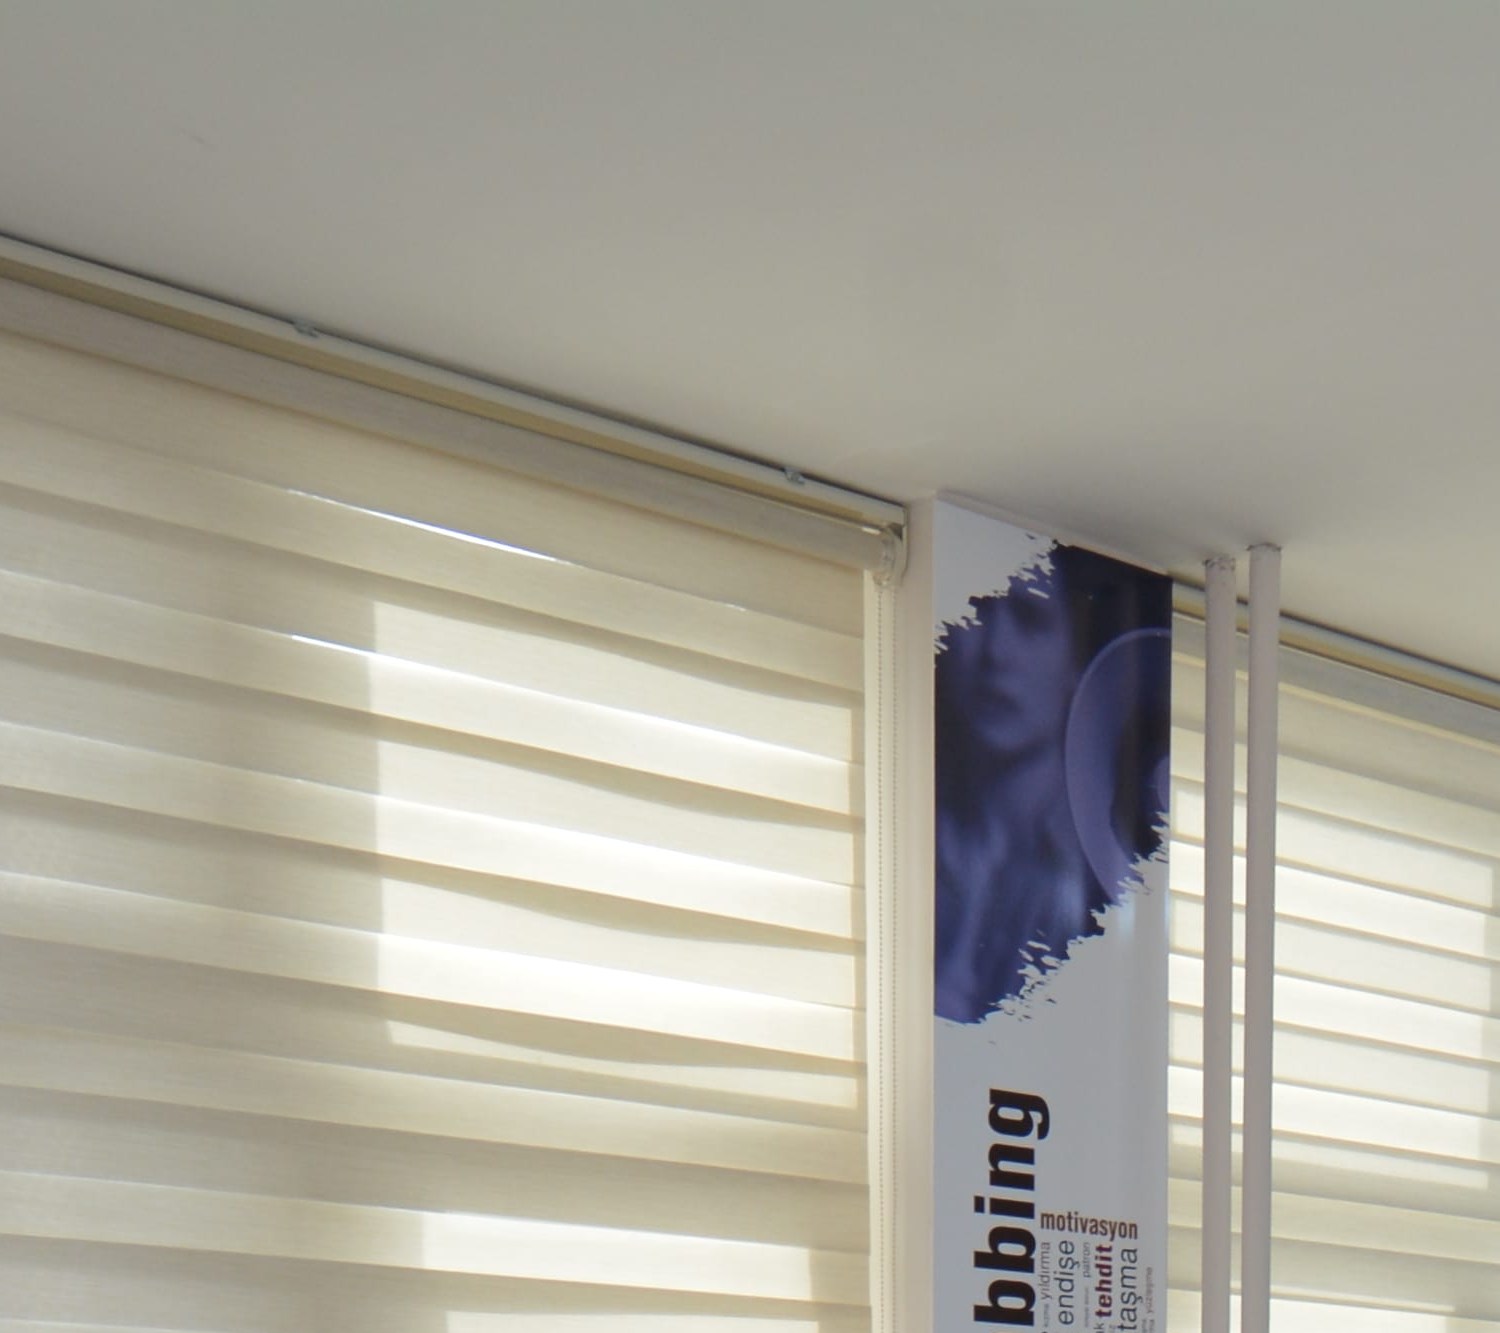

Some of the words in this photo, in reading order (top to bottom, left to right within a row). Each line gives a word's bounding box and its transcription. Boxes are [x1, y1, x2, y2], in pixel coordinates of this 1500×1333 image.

[1040, 1211, 1138, 1242] motivasyon
[1039, 1242, 1053, 1299] yıldırma
[1054, 1240, 1080, 1326] endişe
[1095, 1244, 1112, 1318] tehdit
